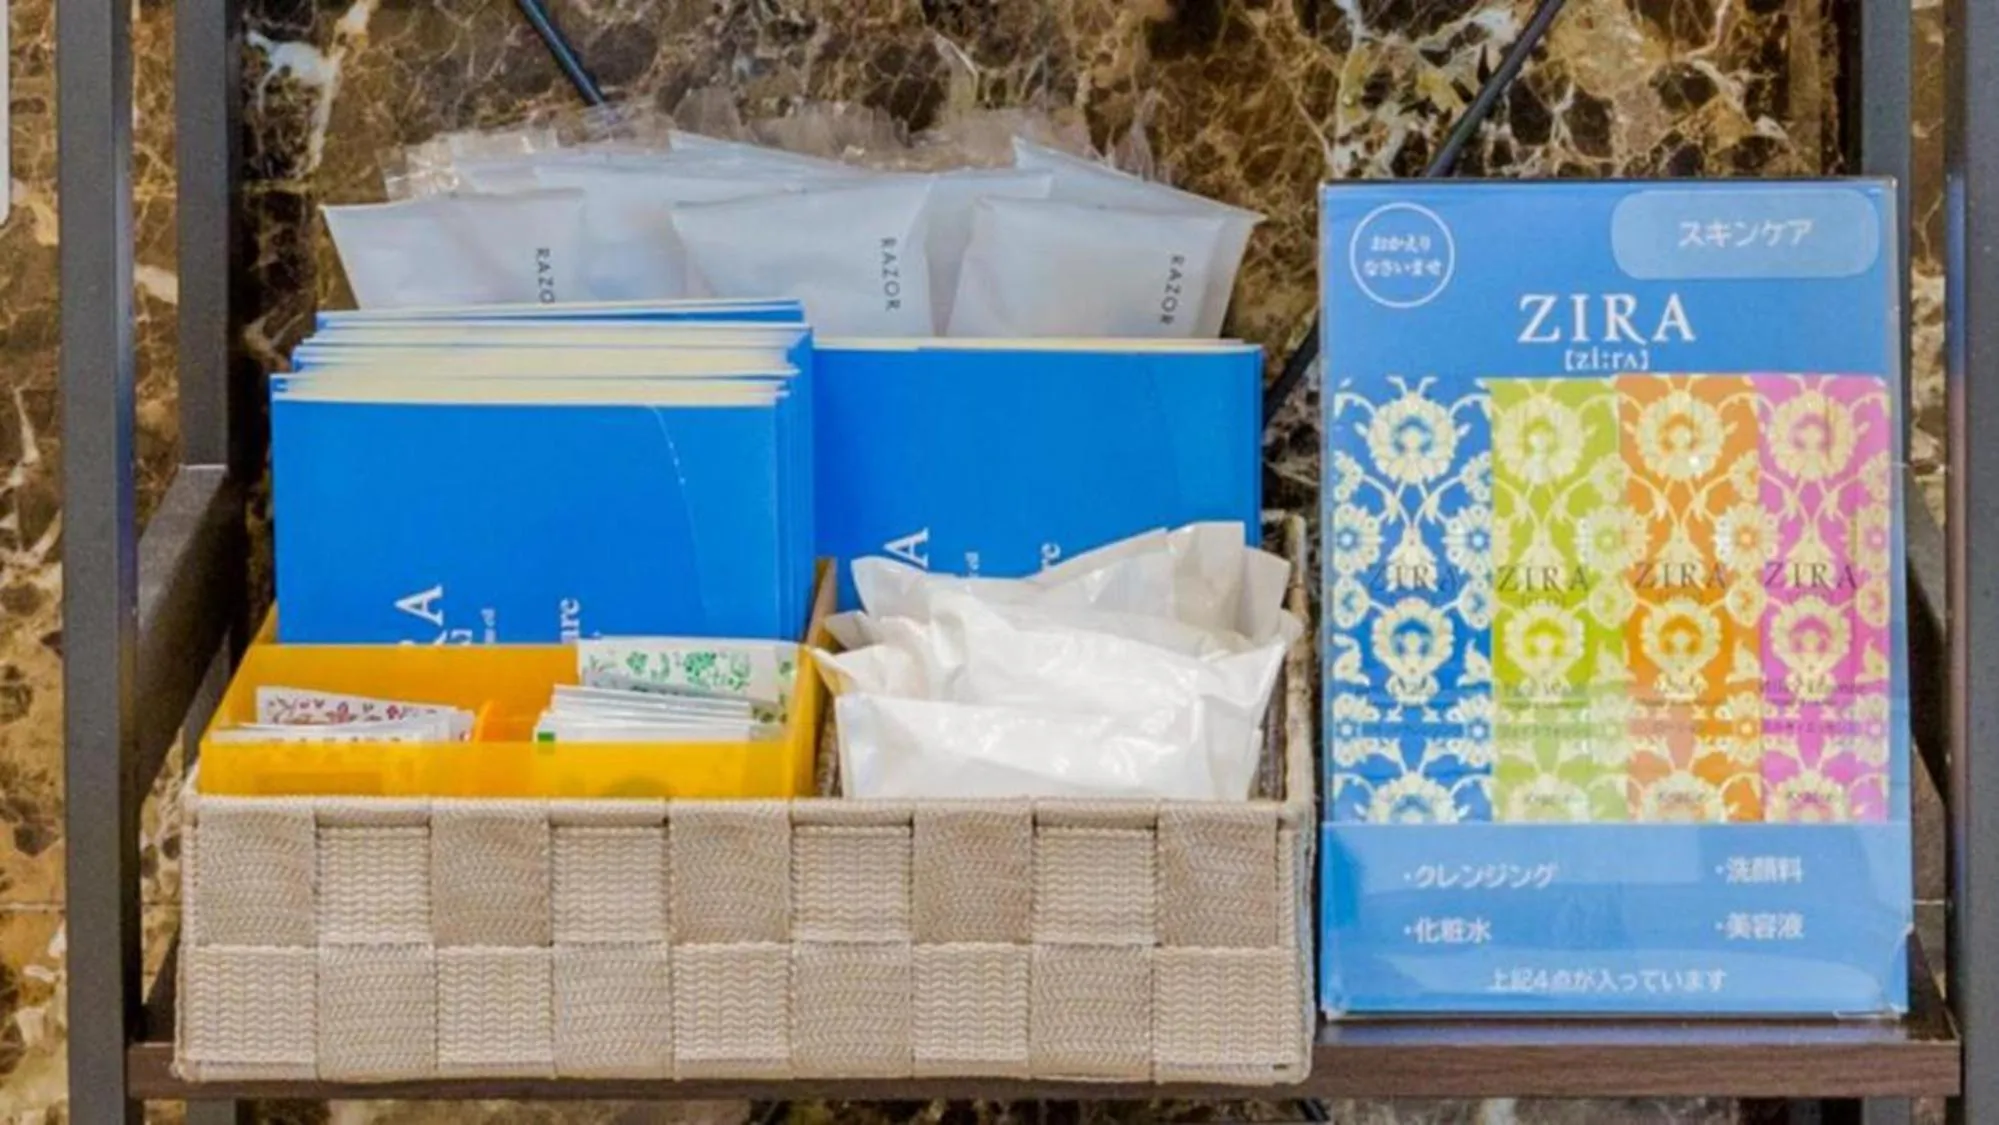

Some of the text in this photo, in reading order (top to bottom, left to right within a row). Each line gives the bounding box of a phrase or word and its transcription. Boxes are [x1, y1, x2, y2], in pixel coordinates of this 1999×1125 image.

[1370, 234, 1431, 253] おかえり
[1679, 219, 1815, 248] スキンケア
[880, 237, 901, 312] RAZOR
[1160, 255, 1185, 325] RAZOR
[1517, 292, 1697, 346] ZIRA
[1369, 564, 1461, 593] ZIRA
[1498, 564, 1591, 594] ZIRA
[1634, 561, 1727, 591] ZIRA
[1764, 561, 1858, 592] ZIRA
[1493, 967, 1728, 993] 上記4点が入っています
